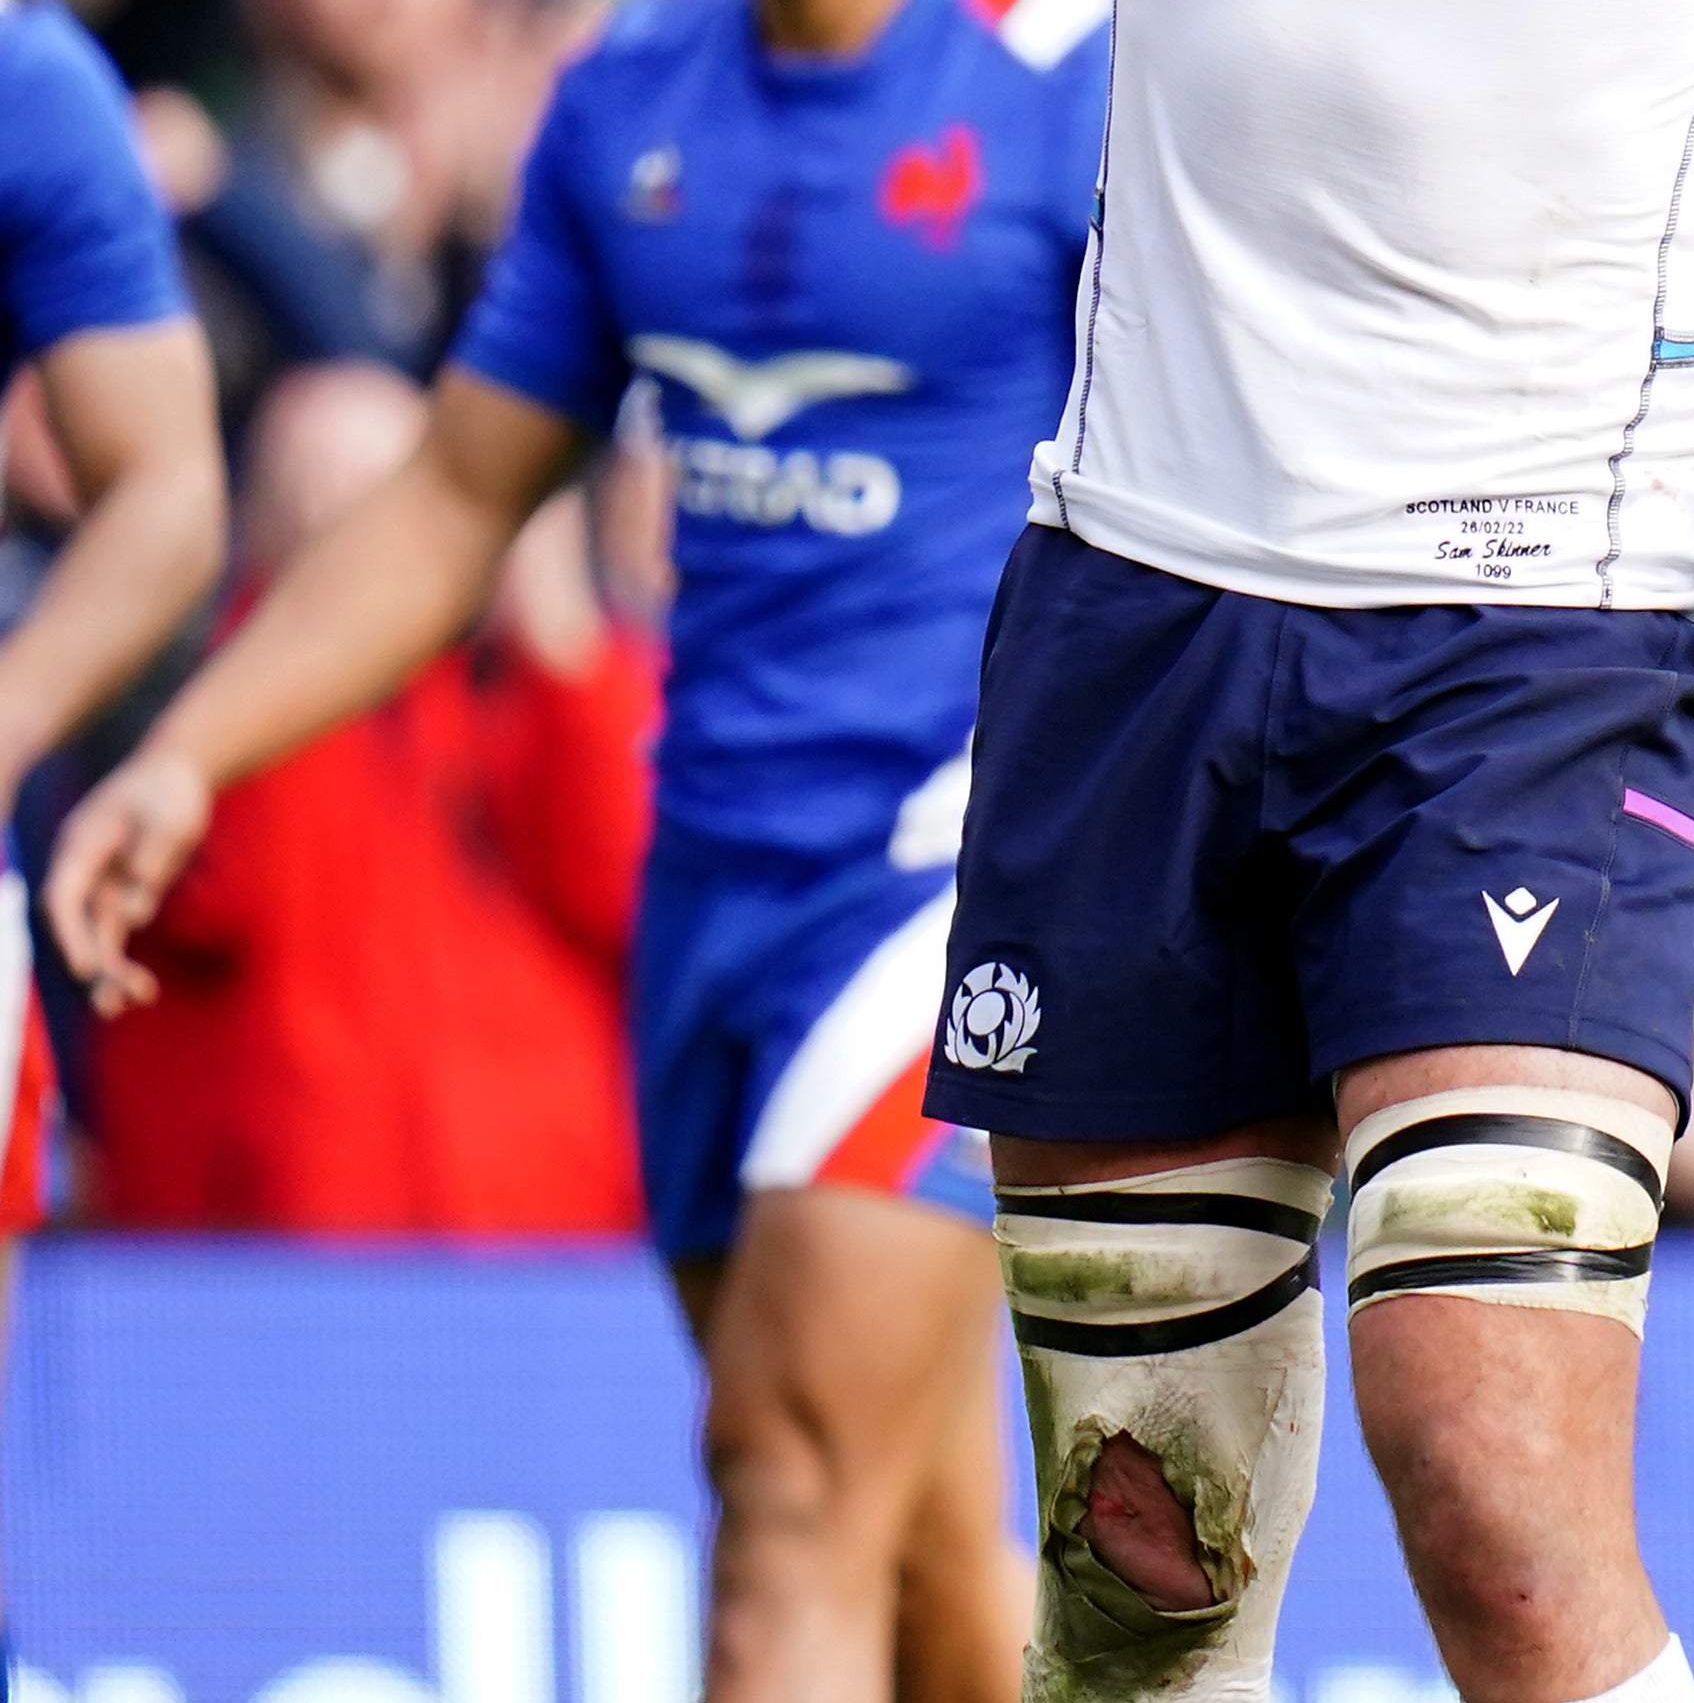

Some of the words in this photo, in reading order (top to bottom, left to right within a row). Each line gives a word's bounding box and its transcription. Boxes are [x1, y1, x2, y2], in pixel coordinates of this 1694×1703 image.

[1405, 499, 1493, 514] SCOTLAND
[1499, 499, 1509, 514] V
[1515, 499, 1580, 515] FRANCE
[1435, 541, 1473, 560] Sam
[1482, 537, 1551, 559] Skinner
[1475, 563, 1512, 579] 1099
